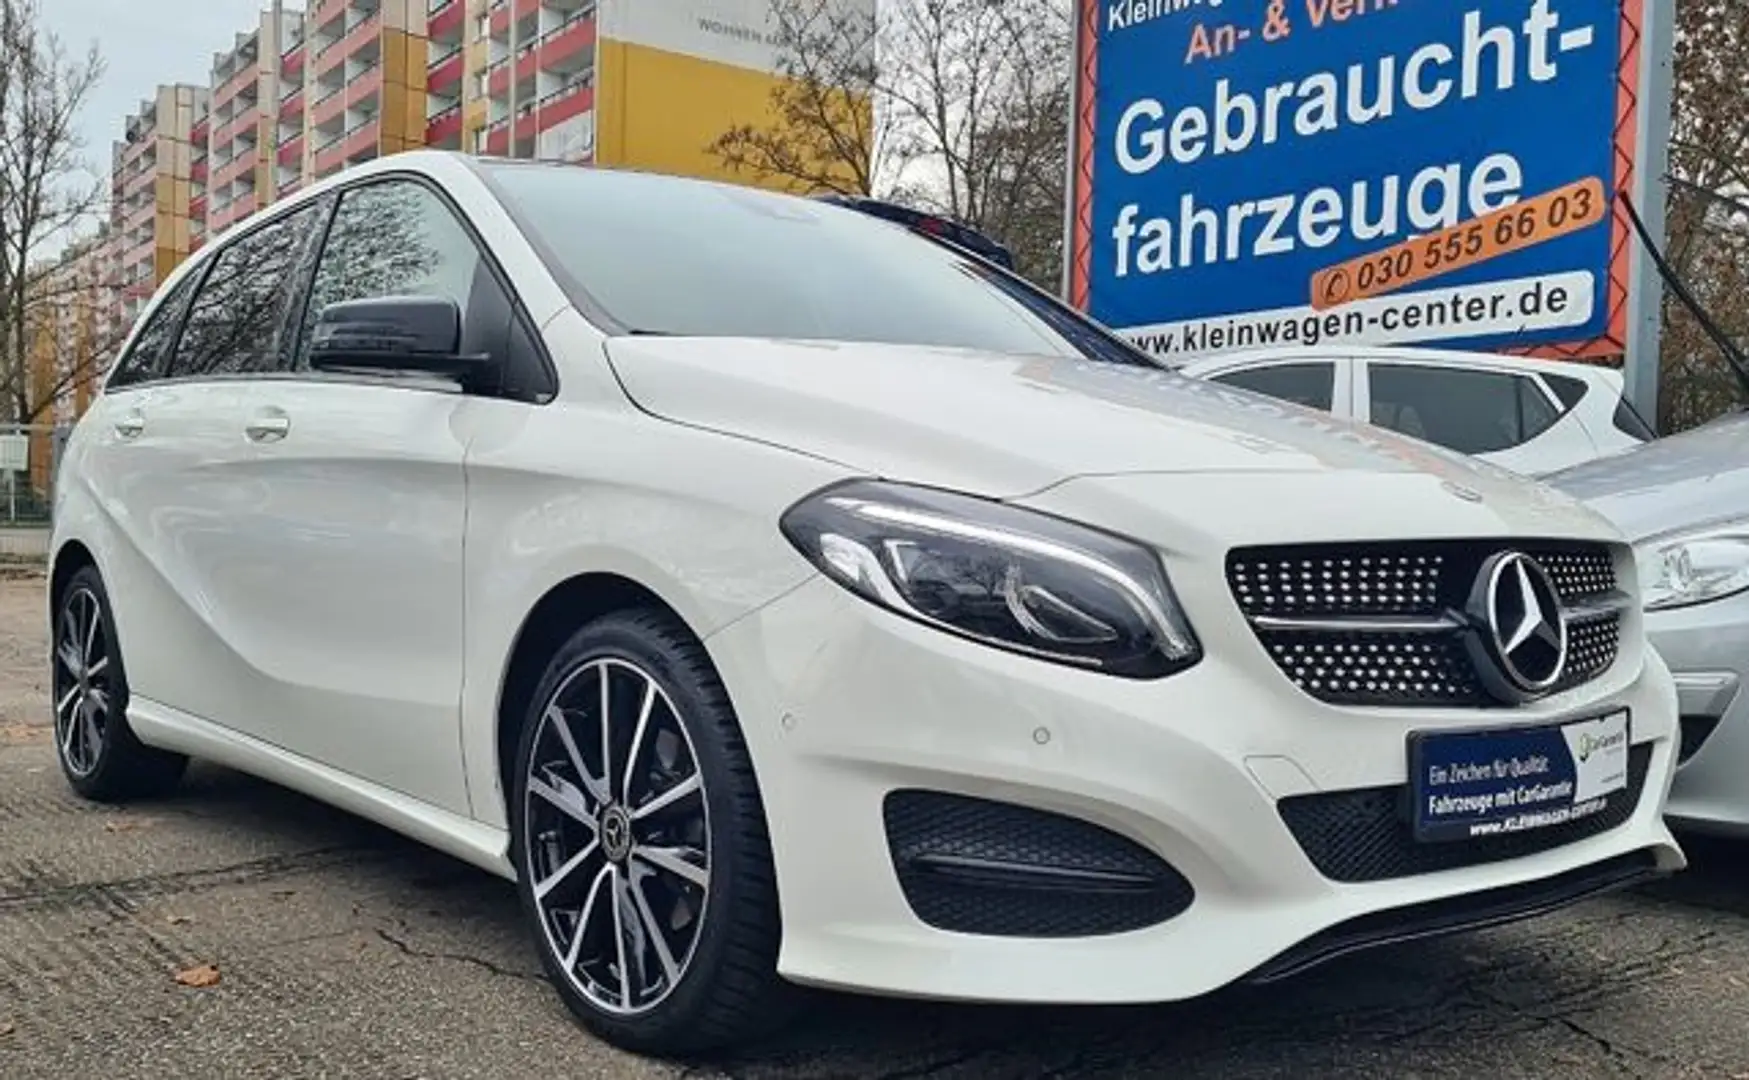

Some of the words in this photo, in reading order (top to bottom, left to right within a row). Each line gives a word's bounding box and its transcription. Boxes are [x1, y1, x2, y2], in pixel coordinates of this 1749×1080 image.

[1184, 22, 1250, 64] An-
[1262, 0, 1291, 41] &
[1114, 0, 1595, 175] Gebraucht-
[1112, 152, 1523, 277] fahrzeuge
[1357, 249, 1413, 290] 030
[1423, 224, 1484, 270] 555
[1494, 207, 1536, 245] 66
[1547, 187, 1592, 228] 03
[1131, 282, 1569, 355] ww.kleinwagen-center.de
[1429, 765, 1447, 786] Ein
[1449, 762, 1491, 784] Zeichen
[1429, 794, 1493, 815] Fahrzeuge
[1495, 787, 1515, 807] mit
